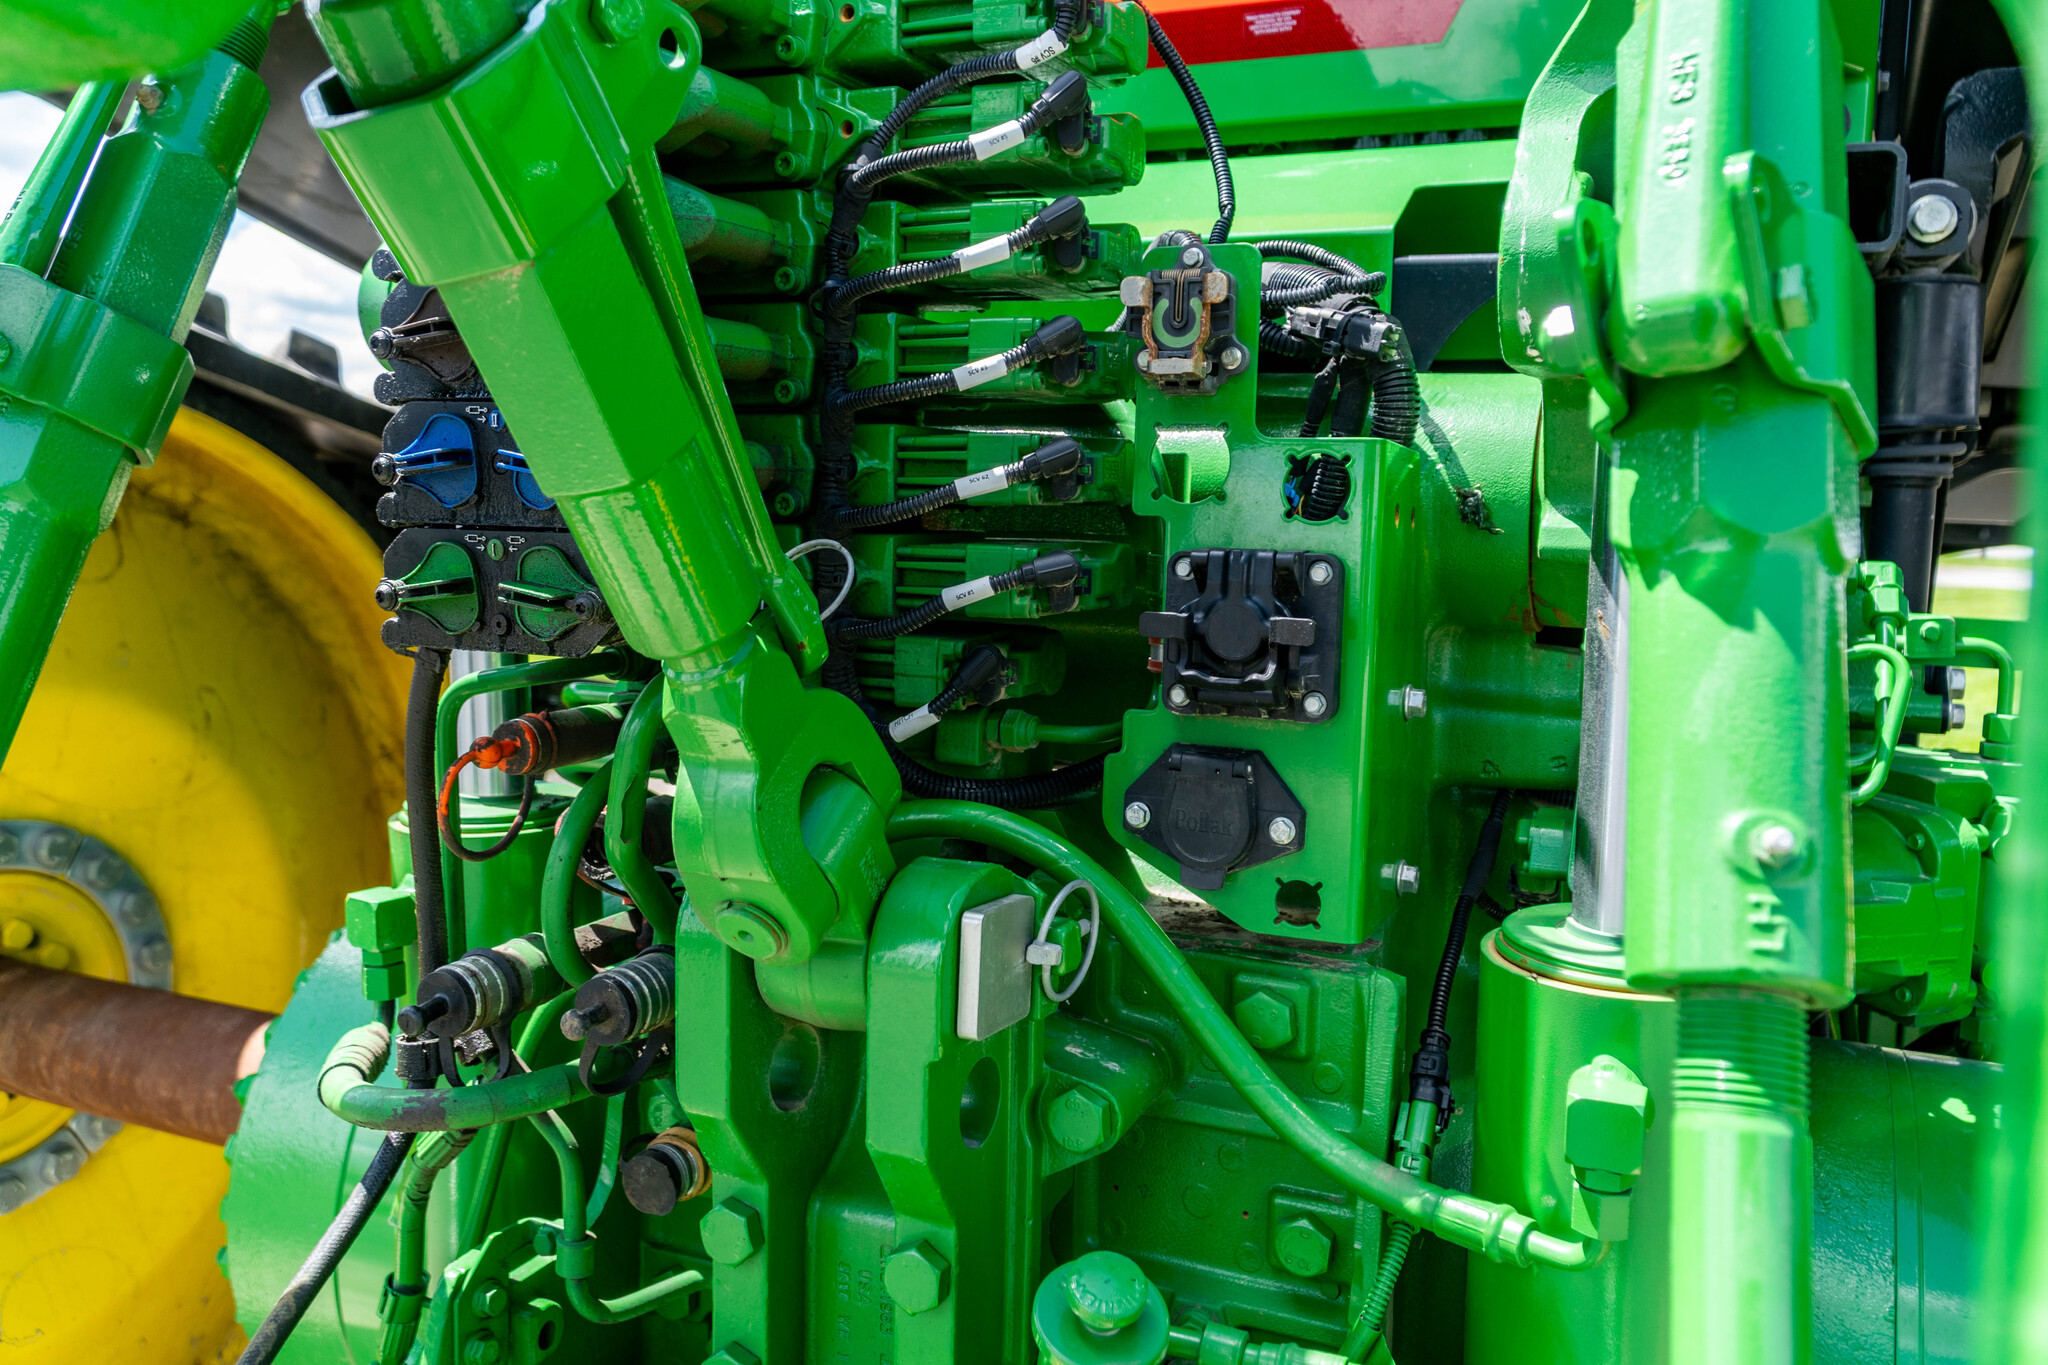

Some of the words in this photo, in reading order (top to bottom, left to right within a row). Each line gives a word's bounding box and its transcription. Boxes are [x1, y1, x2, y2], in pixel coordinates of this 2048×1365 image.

[1040, 46, 1056, 60] SCV
[989, 136, 1000, 146] SCV
[968, 367, 979, 376] SCV
[956, 591, 967, 600] SCV
[894, 712, 914, 727] HITCH
[1174, 808, 1235, 836] Pollak
